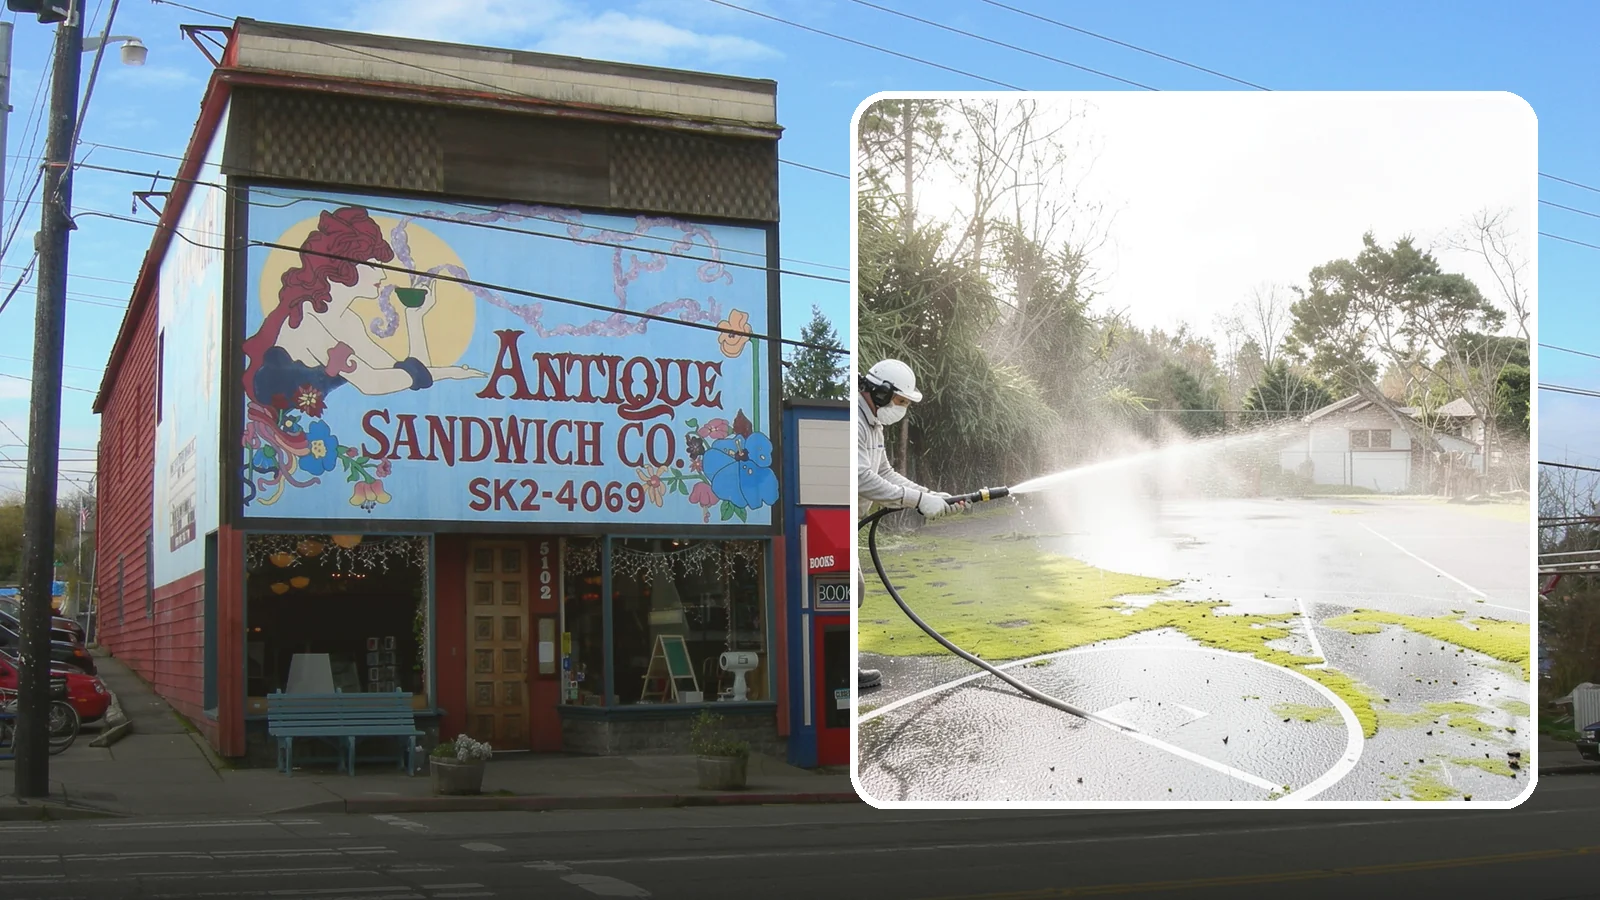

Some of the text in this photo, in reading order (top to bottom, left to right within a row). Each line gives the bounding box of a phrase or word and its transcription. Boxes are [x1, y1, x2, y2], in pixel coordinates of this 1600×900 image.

[476, 329, 724, 421] ANTIQUE
[361, 408, 686, 468] SANDWICH CO.
[468, 478, 646, 513] SK2-4069
[539, 541, 551, 600] 5102
[809, 555, 835, 569] BOOKS
